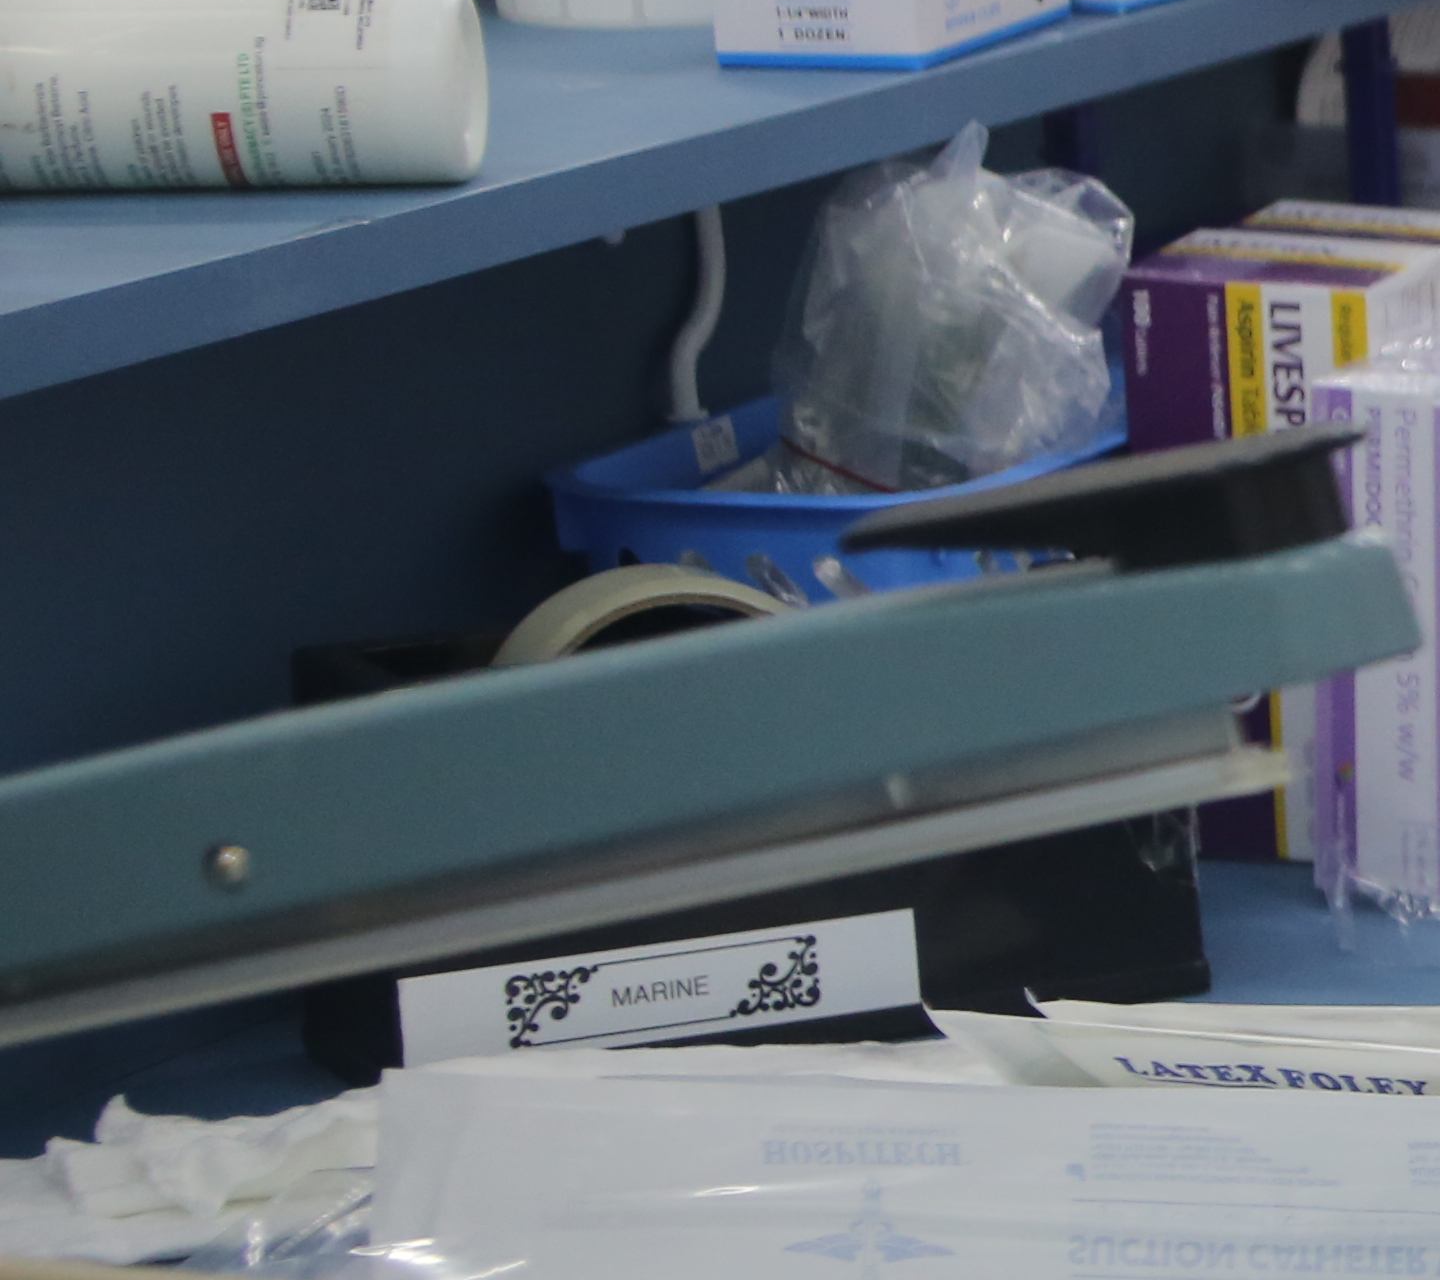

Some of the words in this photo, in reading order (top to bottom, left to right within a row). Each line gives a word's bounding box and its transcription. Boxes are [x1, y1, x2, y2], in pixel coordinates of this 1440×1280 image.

[794, 27, 845, 41] DOZEN
[236, 53, 250, 76] LTD
[238, 77, 252, 100] PTE
[1236, 300, 1258, 380] Aspirin
[1337, 304, 1355, 362] Regula
[1268, 300, 1306, 428] LIVESP
[1365, 406, 1383, 526] PERMIDOC
[1395, 408, 1417, 562] Permethrin
[1396, 672, 1420, 714] 5%
[611, 974, 710, 1008] MARINE
[1112, 1056, 1275, 1086] LATEX
[1282, 1070, 1428, 1096] FOLEY
